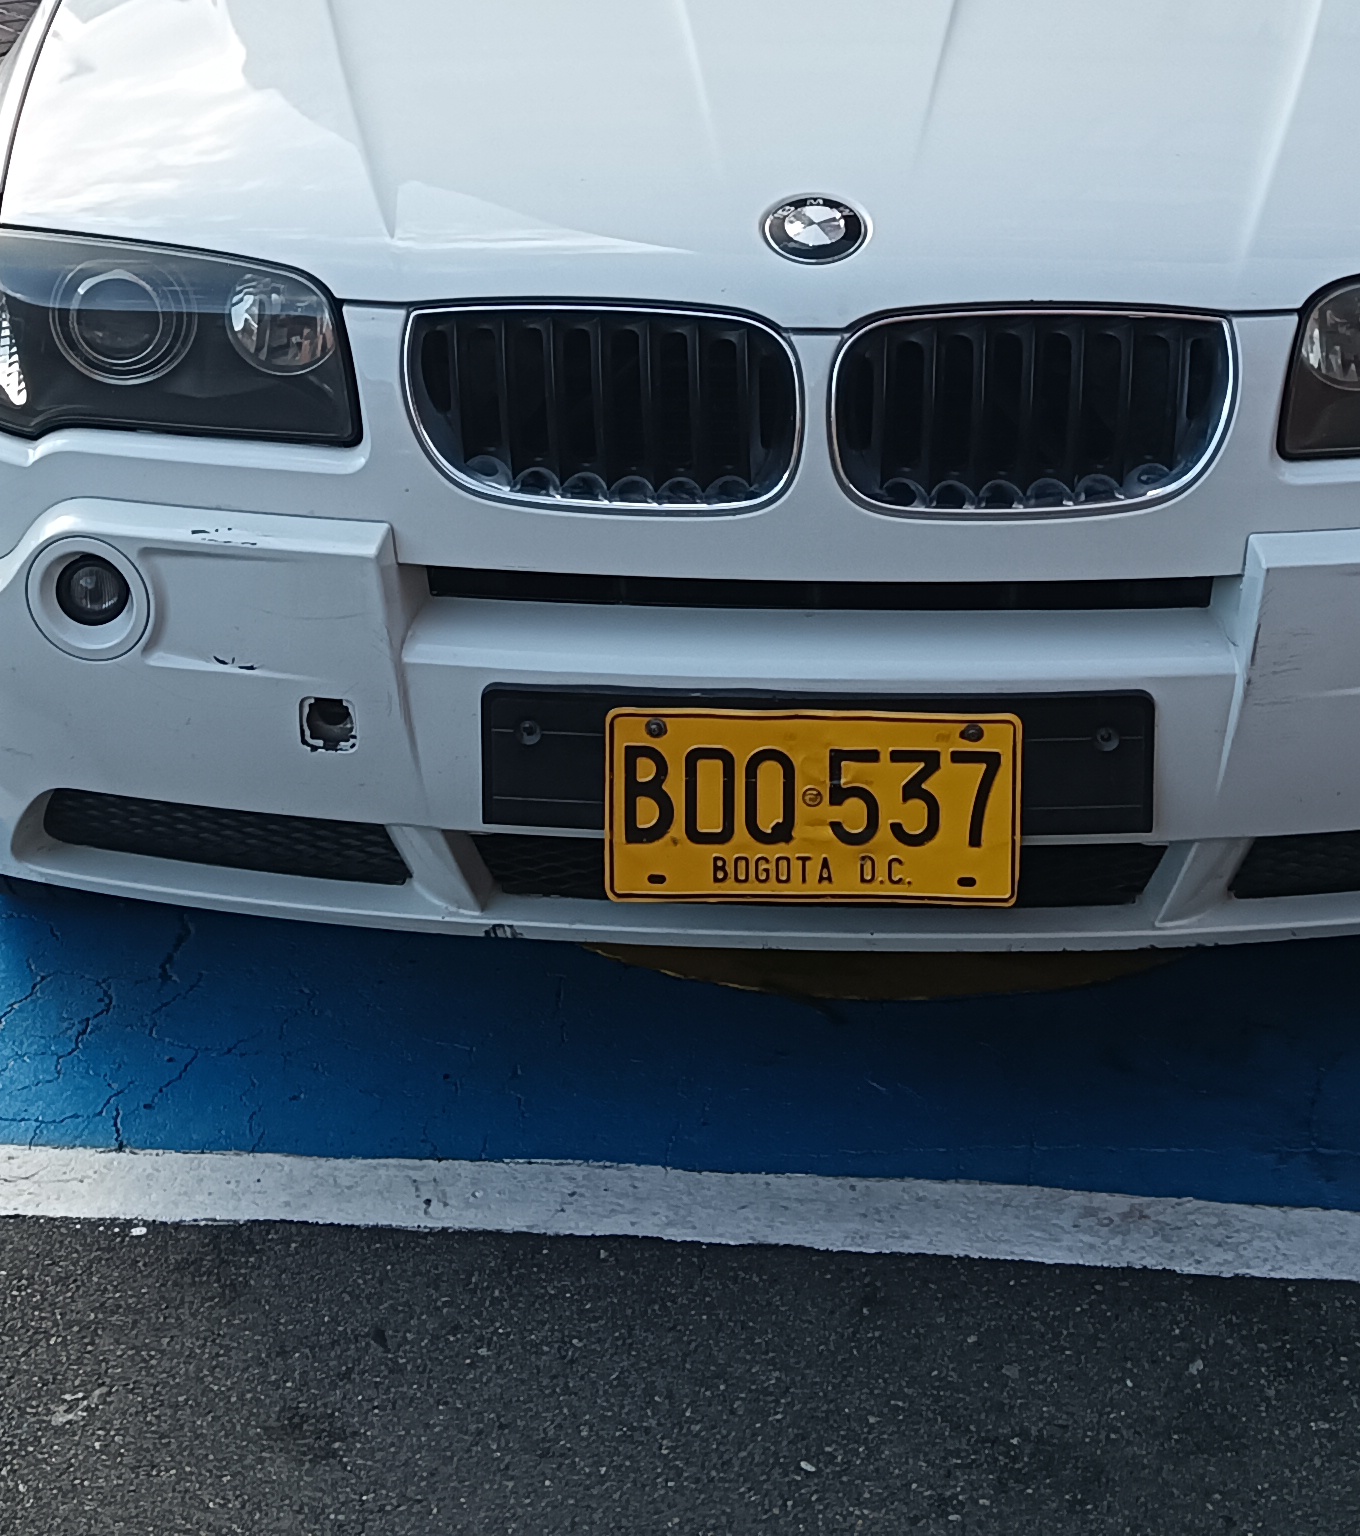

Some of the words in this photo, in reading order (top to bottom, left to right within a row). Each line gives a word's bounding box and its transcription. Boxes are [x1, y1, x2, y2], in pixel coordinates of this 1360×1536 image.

[623, 744, 796, 845] BOQ
[828, 748, 1002, 849] 537
[712, 855, 834, 885] BOGOTA
[858, 855, 913, 886] D.C.
